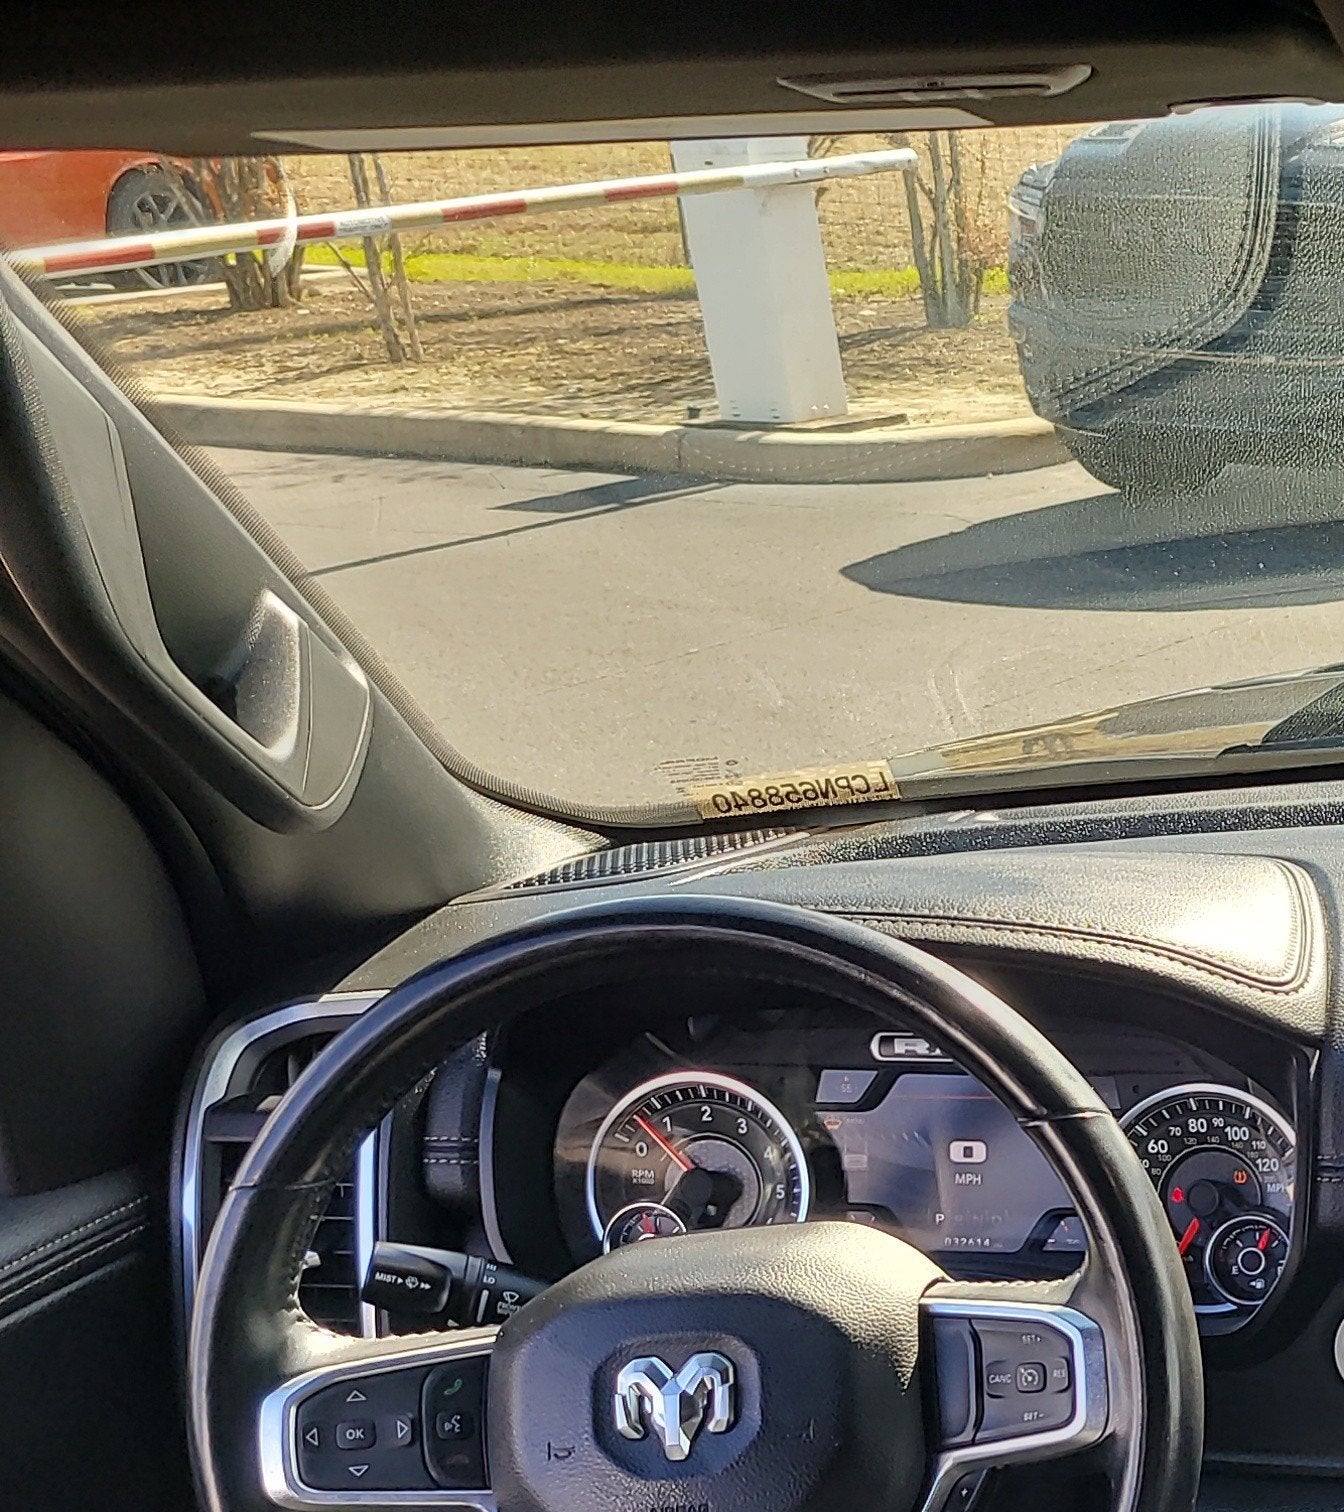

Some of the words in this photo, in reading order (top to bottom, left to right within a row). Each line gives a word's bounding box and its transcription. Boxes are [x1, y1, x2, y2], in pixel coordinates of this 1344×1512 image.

[701, 1106, 713, 1122] 2
[662, 1116, 673, 1132] 1
[736, 1118, 748, 1134] 3
[1187, 1118, 1208, 1133] 80
[1211, 1117, 1225, 1128] 90
[1168, 1126, 1182, 1137] 70
[1224, 1126, 1249, 1142] 100
[635, 1141, 649, 1158] 0
[1147, 1139, 1169, 1154] 60
[1252, 1140, 1267, 1150] 110
[763, 1145, 773, 1160] 4
[1256, 1158, 1279, 1172] 120
[632, 1169, 655, 1179] RPM
[954, 1173, 982, 1186] MPH
[775, 1184, 786, 1200] 5
[935, 1213, 945, 1225] P
[374, 1272, 397, 1284] MIST
[346, 1428, 364, 1440] OK
